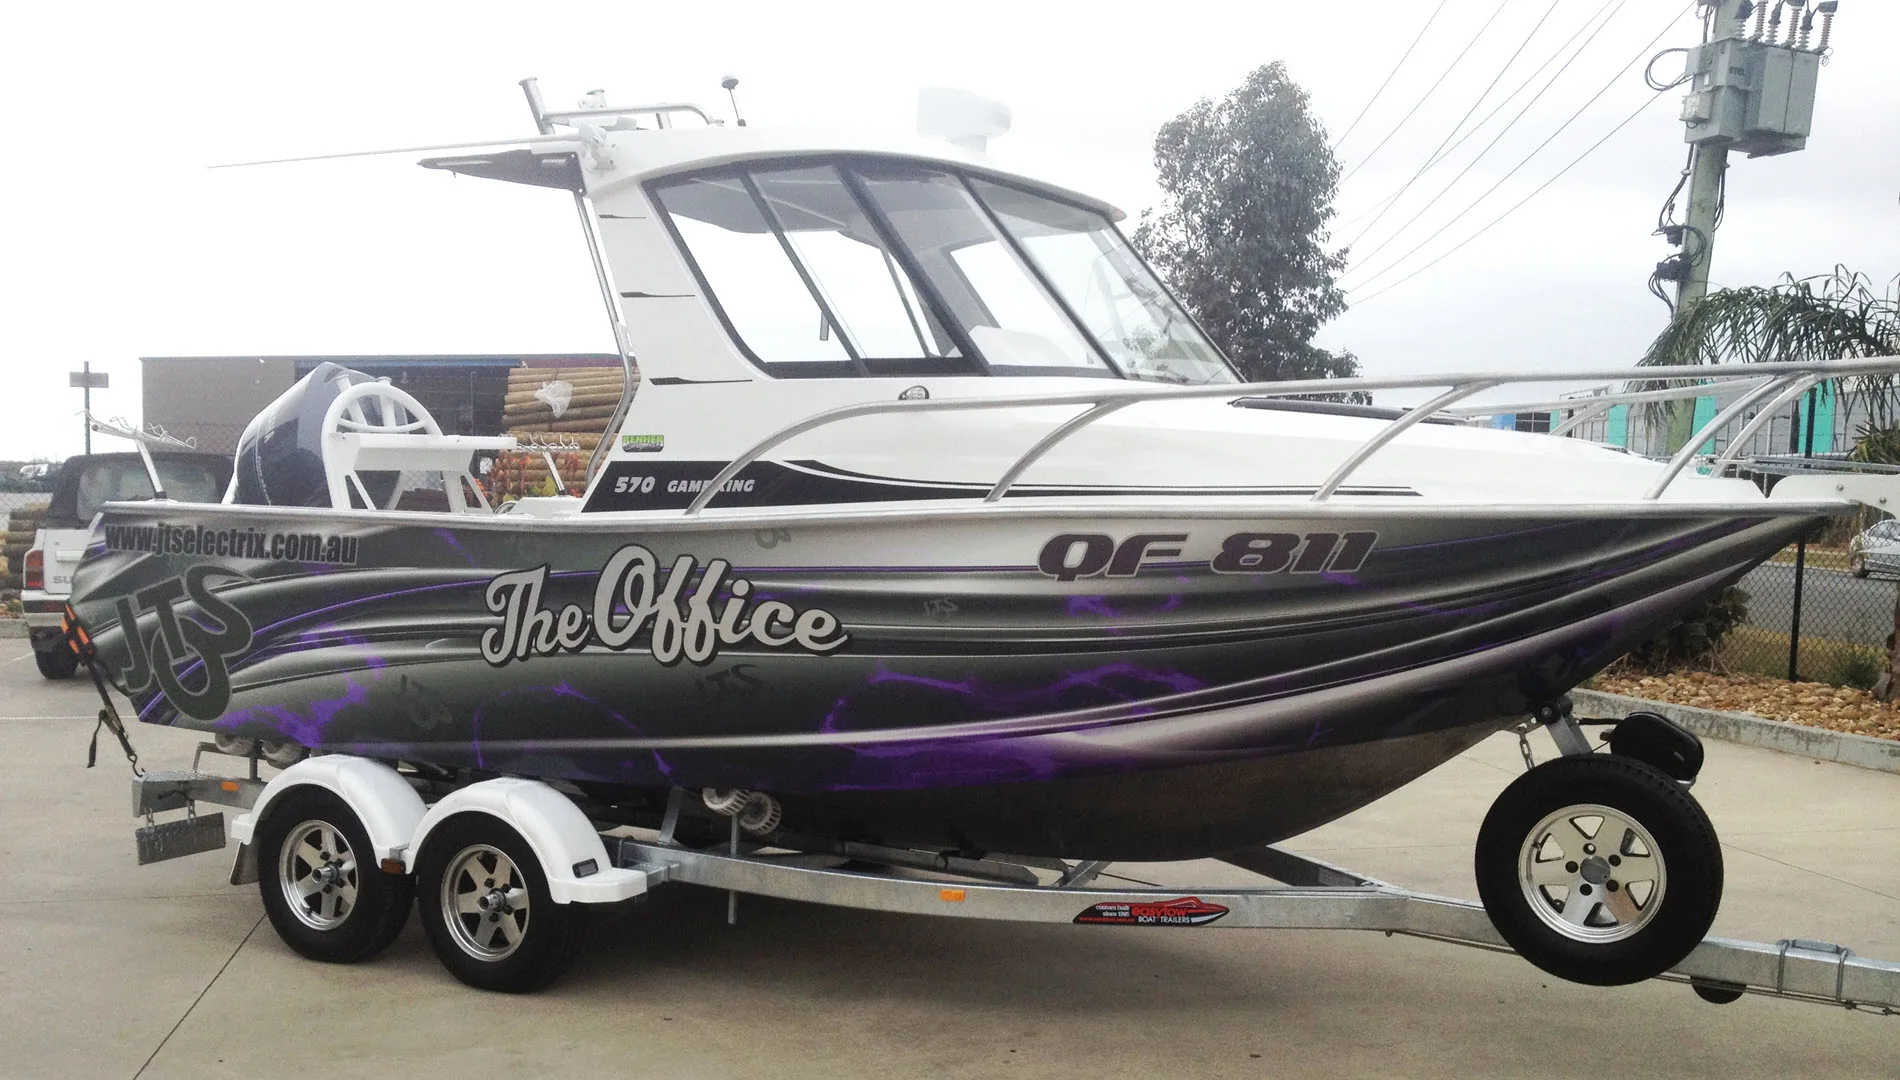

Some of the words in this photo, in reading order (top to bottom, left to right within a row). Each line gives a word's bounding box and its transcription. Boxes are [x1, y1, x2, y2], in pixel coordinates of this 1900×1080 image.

[614, 476, 655, 493] 570
[104, 522, 360, 566] www.jtselectrix.com.au
[1037, 531, 1190, 581] QF
[1210, 531, 1380, 575] 811
[480, 561, 593, 668] The
[592, 543, 852, 668] Office
[113, 564, 262, 722] JTS
[1138, 915, 1157, 923] BOAT
[1160, 915, 1190, 924] TRAILERS
